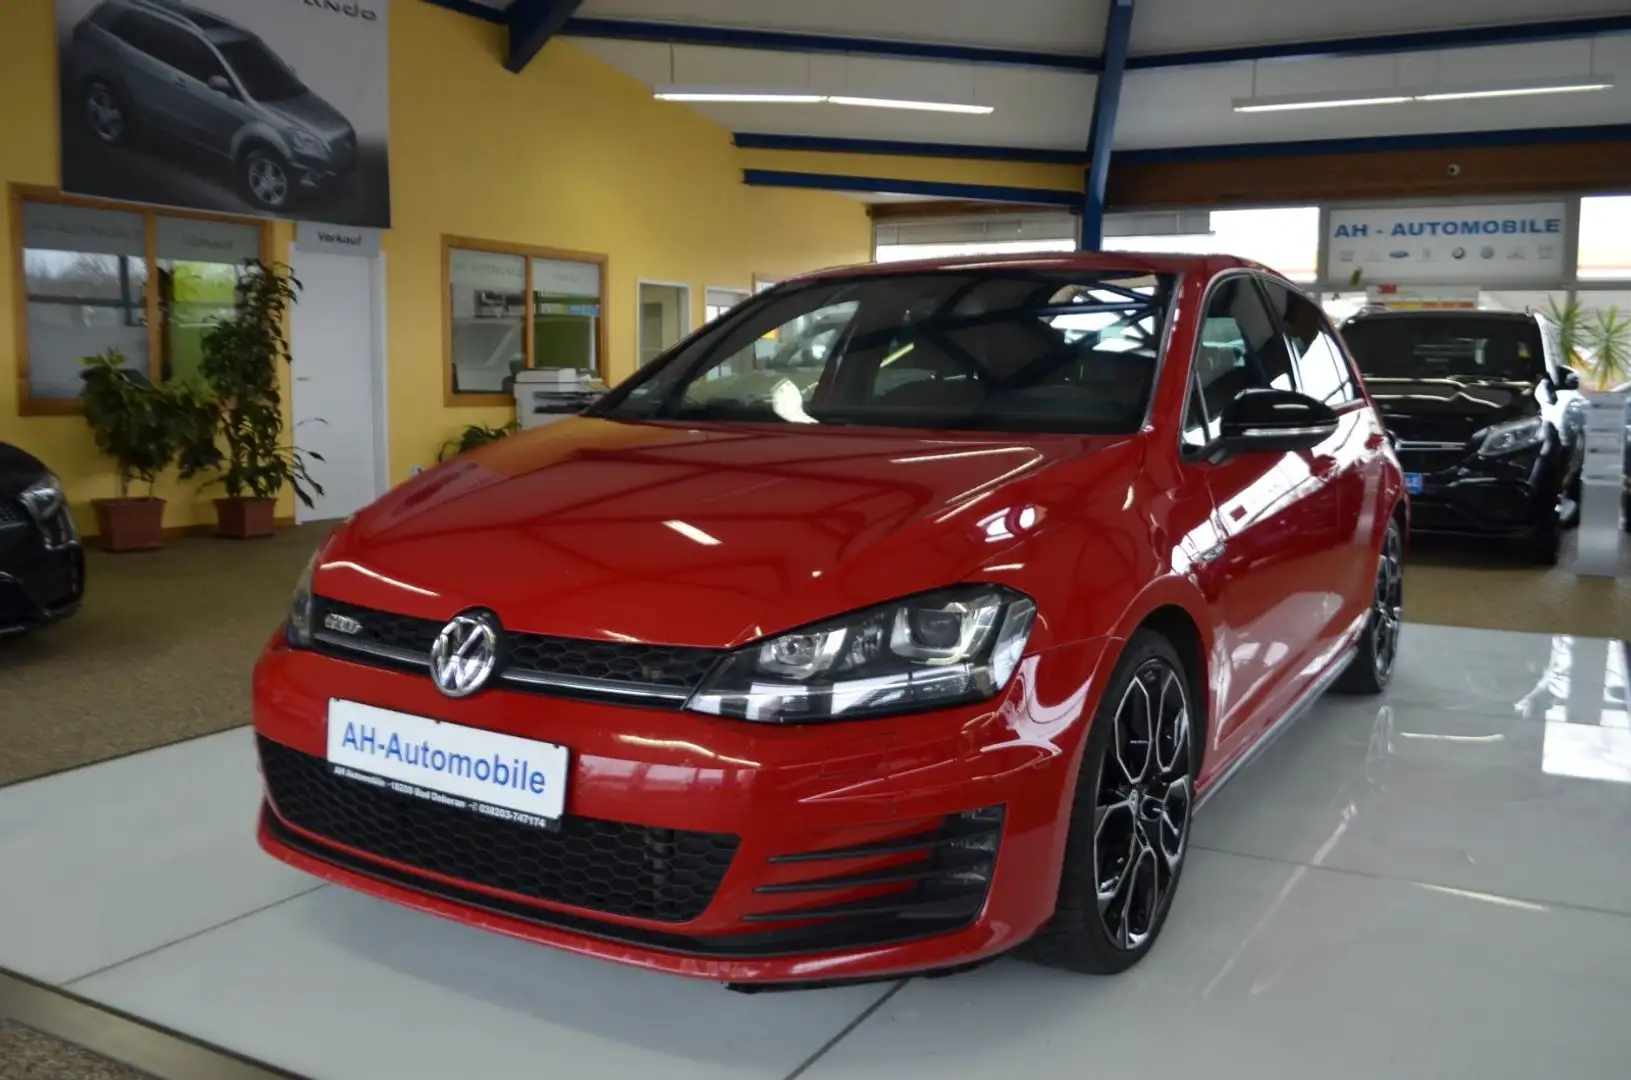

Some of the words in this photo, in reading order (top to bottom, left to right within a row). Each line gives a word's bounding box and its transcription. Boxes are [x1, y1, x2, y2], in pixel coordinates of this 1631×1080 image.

[316, 230, 362, 246] Verkauf
[1334, 223, 1368, 238] AH
[1391, 218, 1561, 238] AUTOMOBILE
[341, 720, 546, 795] AH-Automobile
